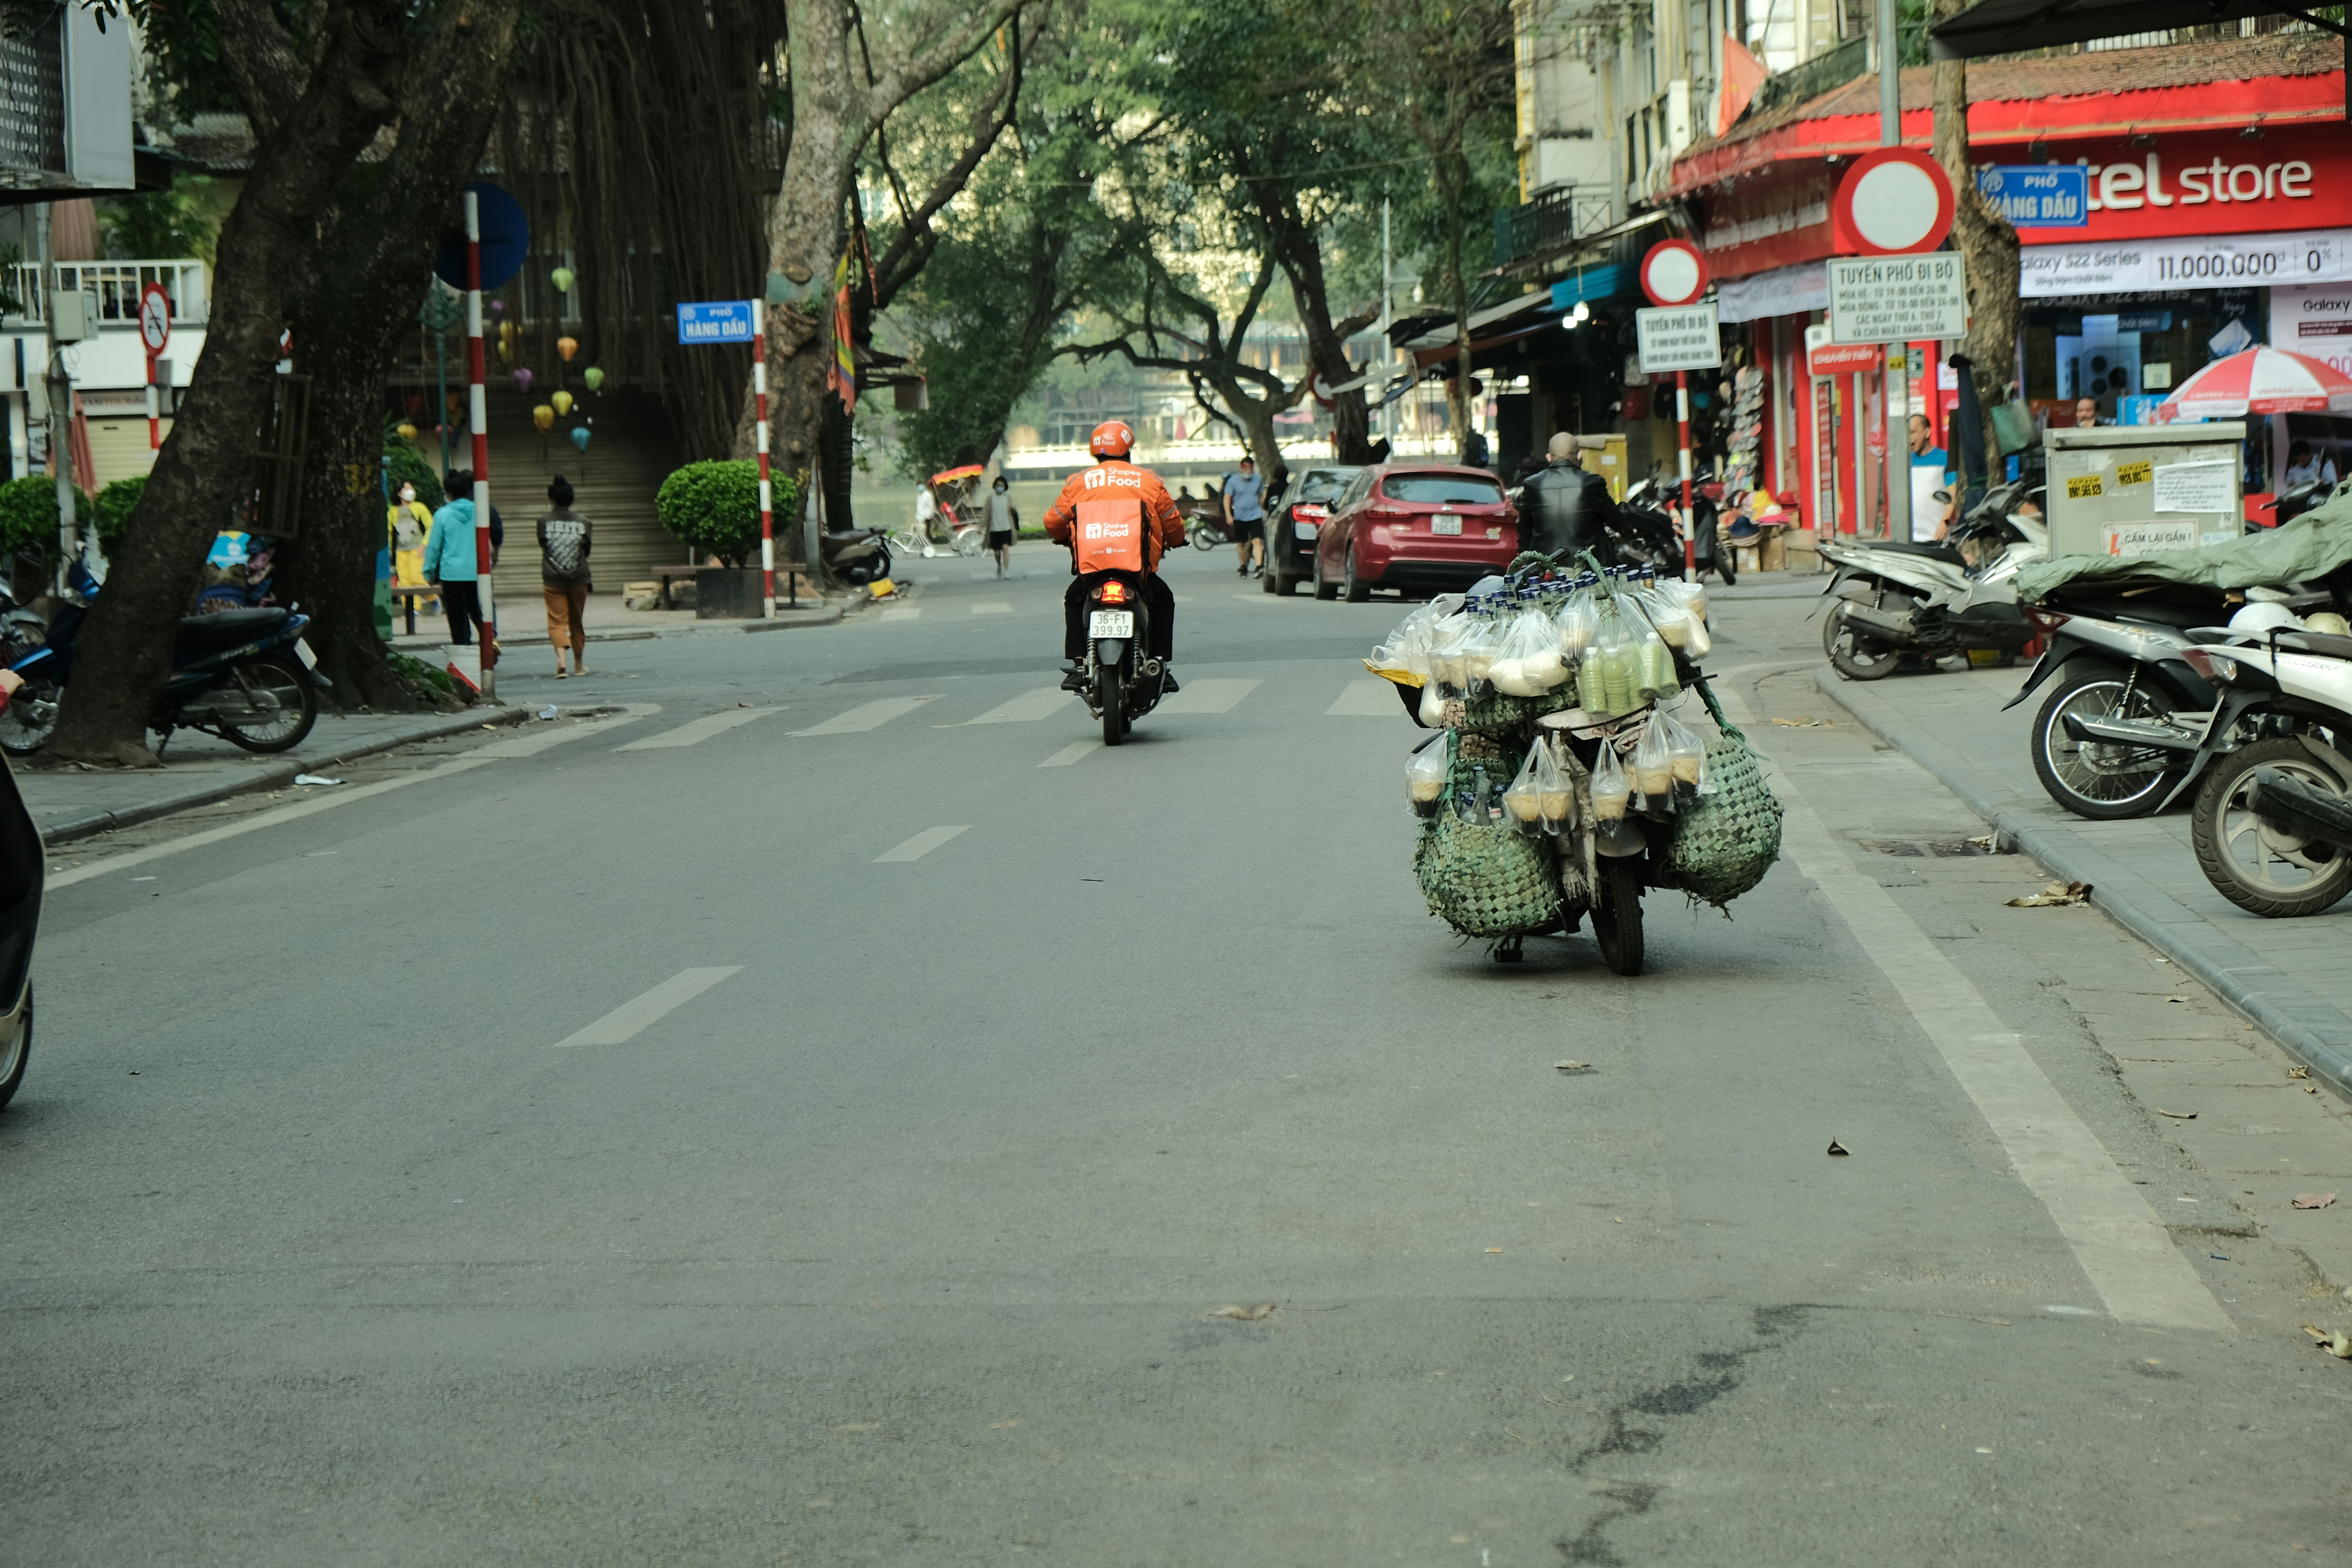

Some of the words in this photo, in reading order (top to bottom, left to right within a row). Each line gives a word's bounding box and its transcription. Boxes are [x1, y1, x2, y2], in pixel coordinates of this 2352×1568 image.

[2024, 172, 2059, 188] PHỐ
[2179, 156, 2312, 203] store
[2021, 255, 2063, 275] alaxy
[2065, 251, 2090, 269] S22
[2093, 249, 2141, 268] Series
[1838, 260, 1882, 285] TUYẾN
[1886, 259, 1915, 282] PHỐ
[1917, 263, 1930, 280] ĐI
[1935, 259, 1953, 281] BỘ
[709, 305, 733, 317] PHỐ
[2303, 298, 2350, 315] Galaxy
[686, 320, 720, 337] HÀNG
[1108, 467, 1141, 477] Shopee
[1107, 475, 1141, 488] Food
[1103, 528, 1129, 538] Food
[1097, 614, 1125, 624] 36-F1
[1093, 626, 1129, 635] 399.97
